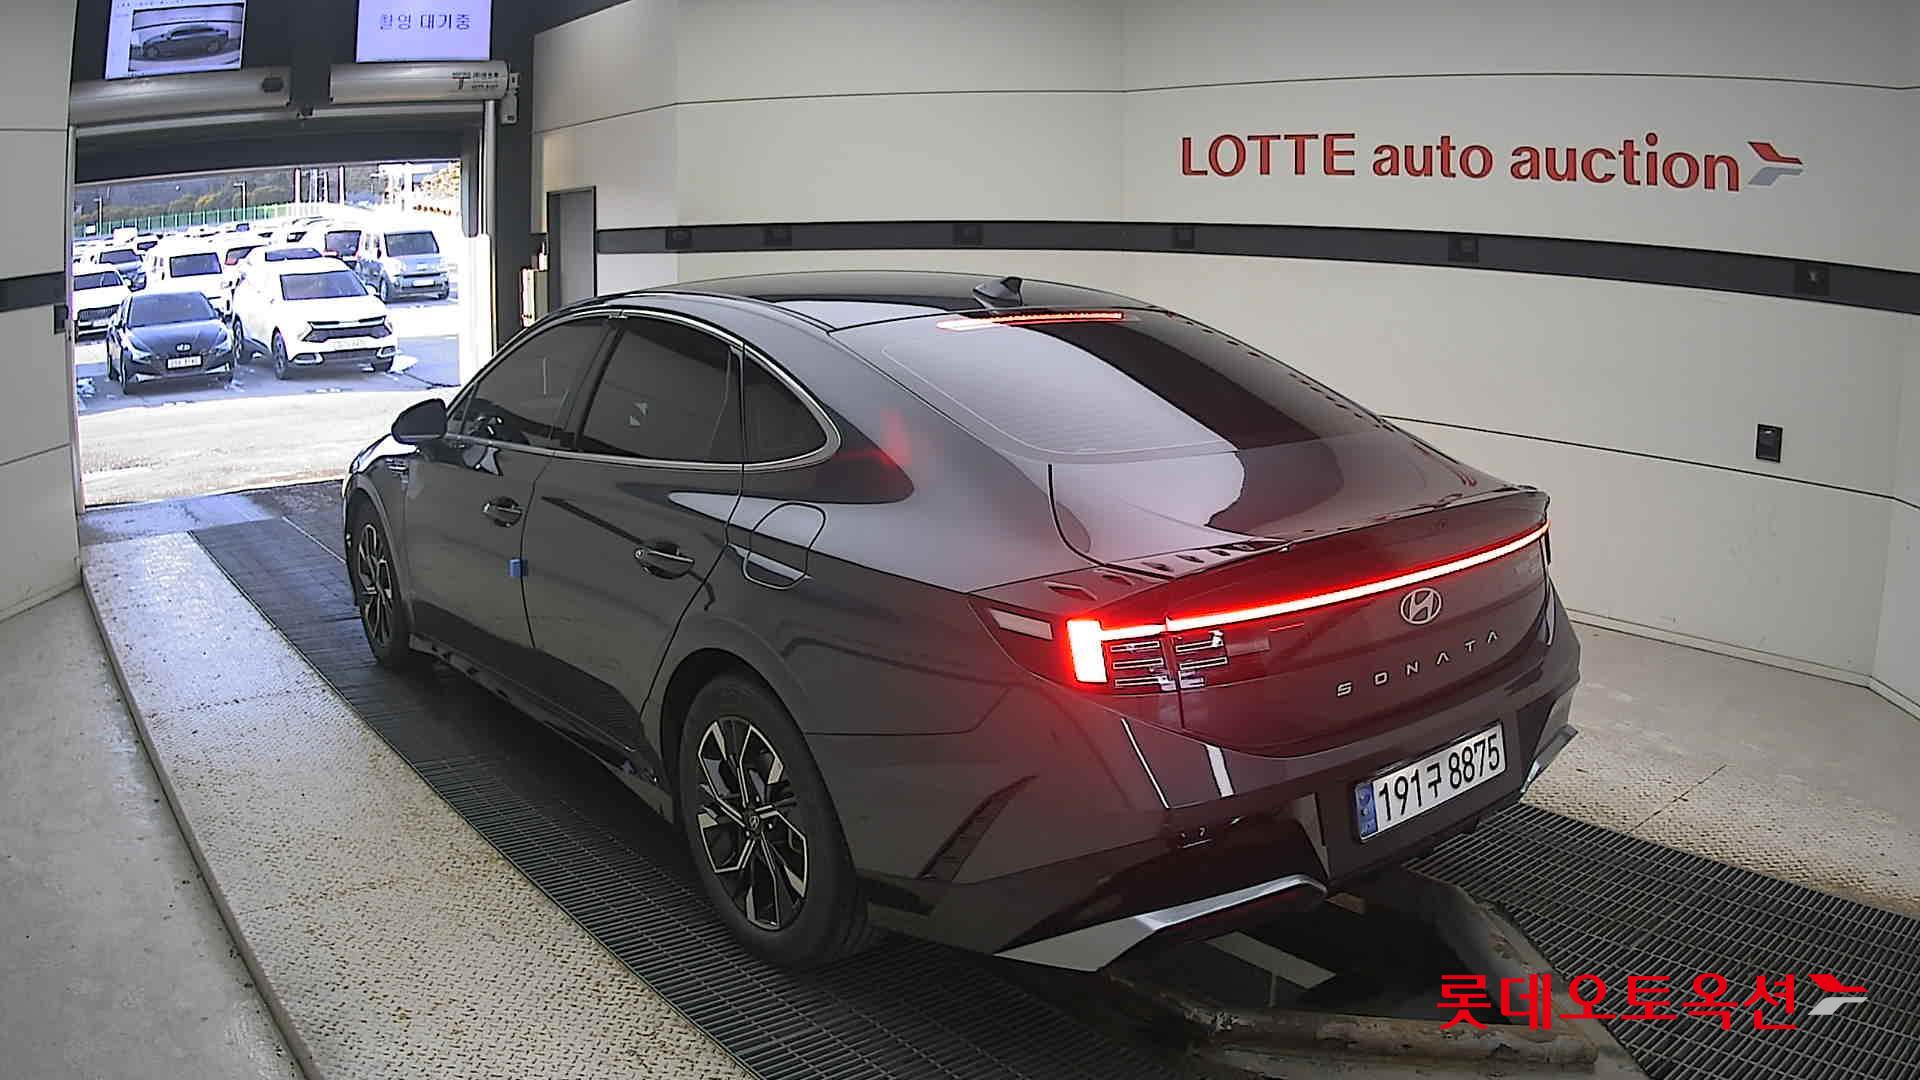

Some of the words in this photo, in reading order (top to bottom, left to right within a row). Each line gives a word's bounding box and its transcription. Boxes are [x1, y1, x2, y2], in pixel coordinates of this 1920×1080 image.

[1182, 132, 1356, 177] LOTTE
[1373, 135, 1493, 179] auto
[1510, 132, 1740, 191] auction
[1336, 630, 1499, 697] SONATA
[1448, 733, 1501, 790] 8875
